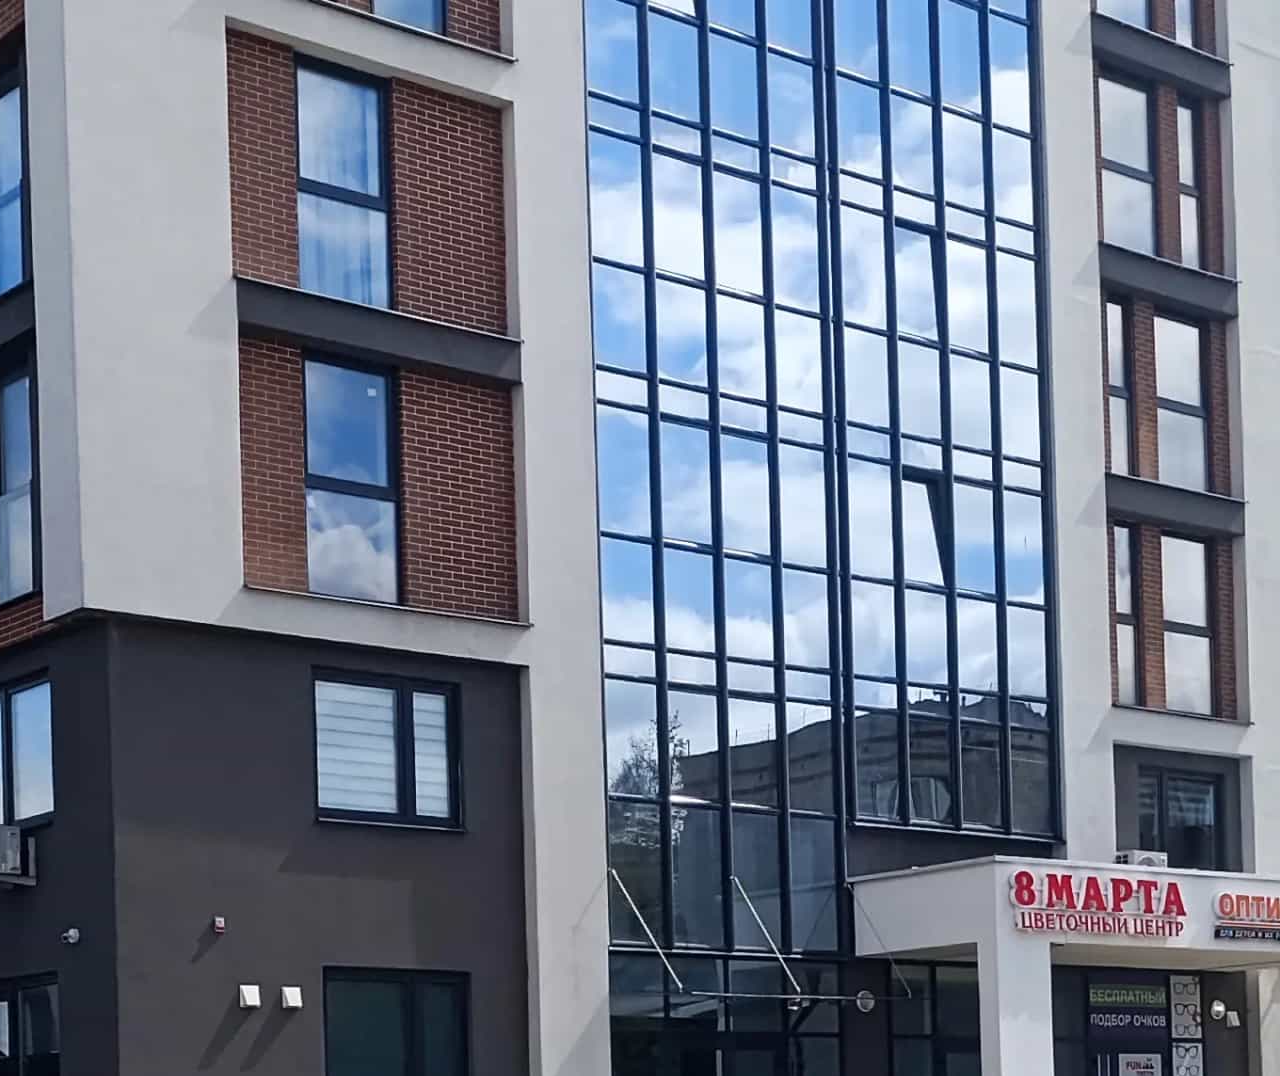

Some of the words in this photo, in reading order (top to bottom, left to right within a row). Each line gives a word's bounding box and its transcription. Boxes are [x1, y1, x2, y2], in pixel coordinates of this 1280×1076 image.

[1015, 871, 1036, 906] 8
[1046, 874, 1187, 916] МАРТА
[1021, 911, 1127, 934] ЦВЕТОЧНЫЙ
[1134, 917, 1184, 937] ЦЕНТР
[1089, 988, 1167, 1005] БЕСПЛАТНЫЙ
[1090, 1014, 1131, 1027] ПОДБОР
[1133, 1014, 1167, 1027] ОЧКОВ
